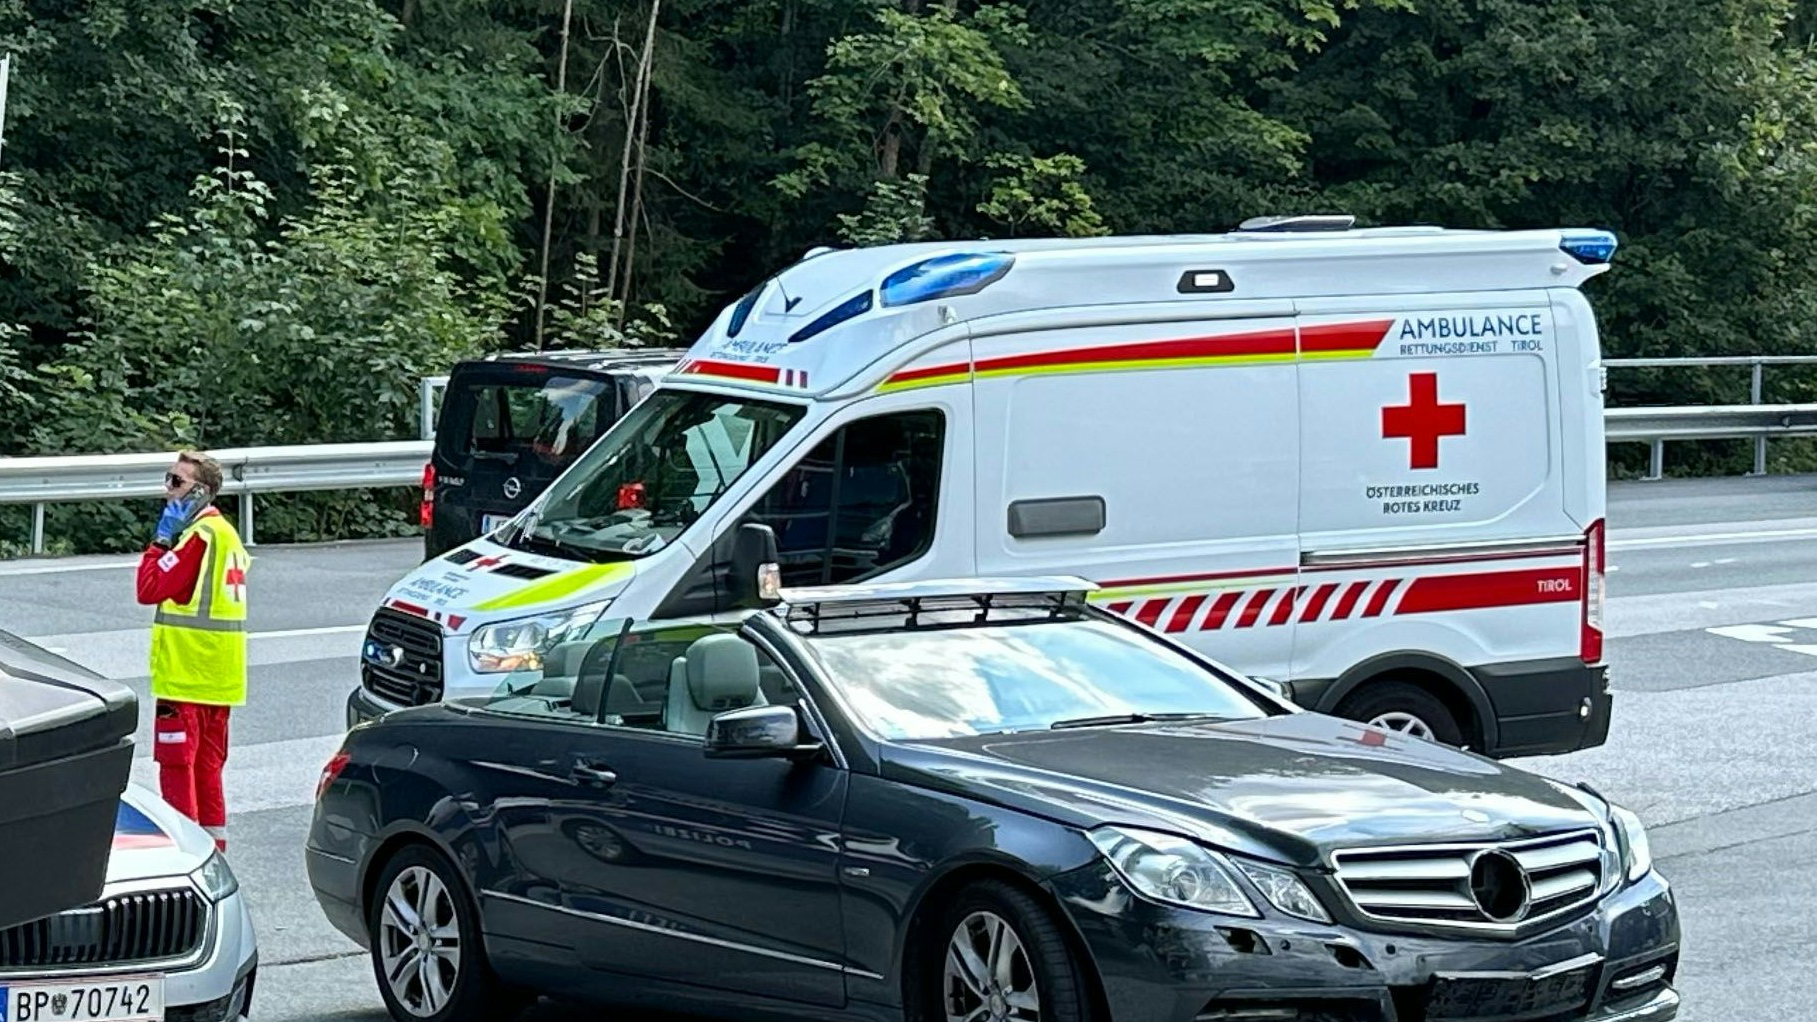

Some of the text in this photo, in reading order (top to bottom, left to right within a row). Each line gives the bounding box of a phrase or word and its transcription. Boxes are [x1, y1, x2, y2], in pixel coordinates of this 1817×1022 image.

[1399, 314, 1543, 340] AMBULANCE
[1400, 340, 1544, 355] RETTUNGSDIENST TIROL
[1366, 482, 1480, 499] ÖSTERREICHISCHES
[1383, 499, 1462, 515] ROTES KREUZ
[1537, 578, 1573, 593] TIROL
[16, 991, 50, 1022] BP
[71, 984, 151, 1019] 70742
